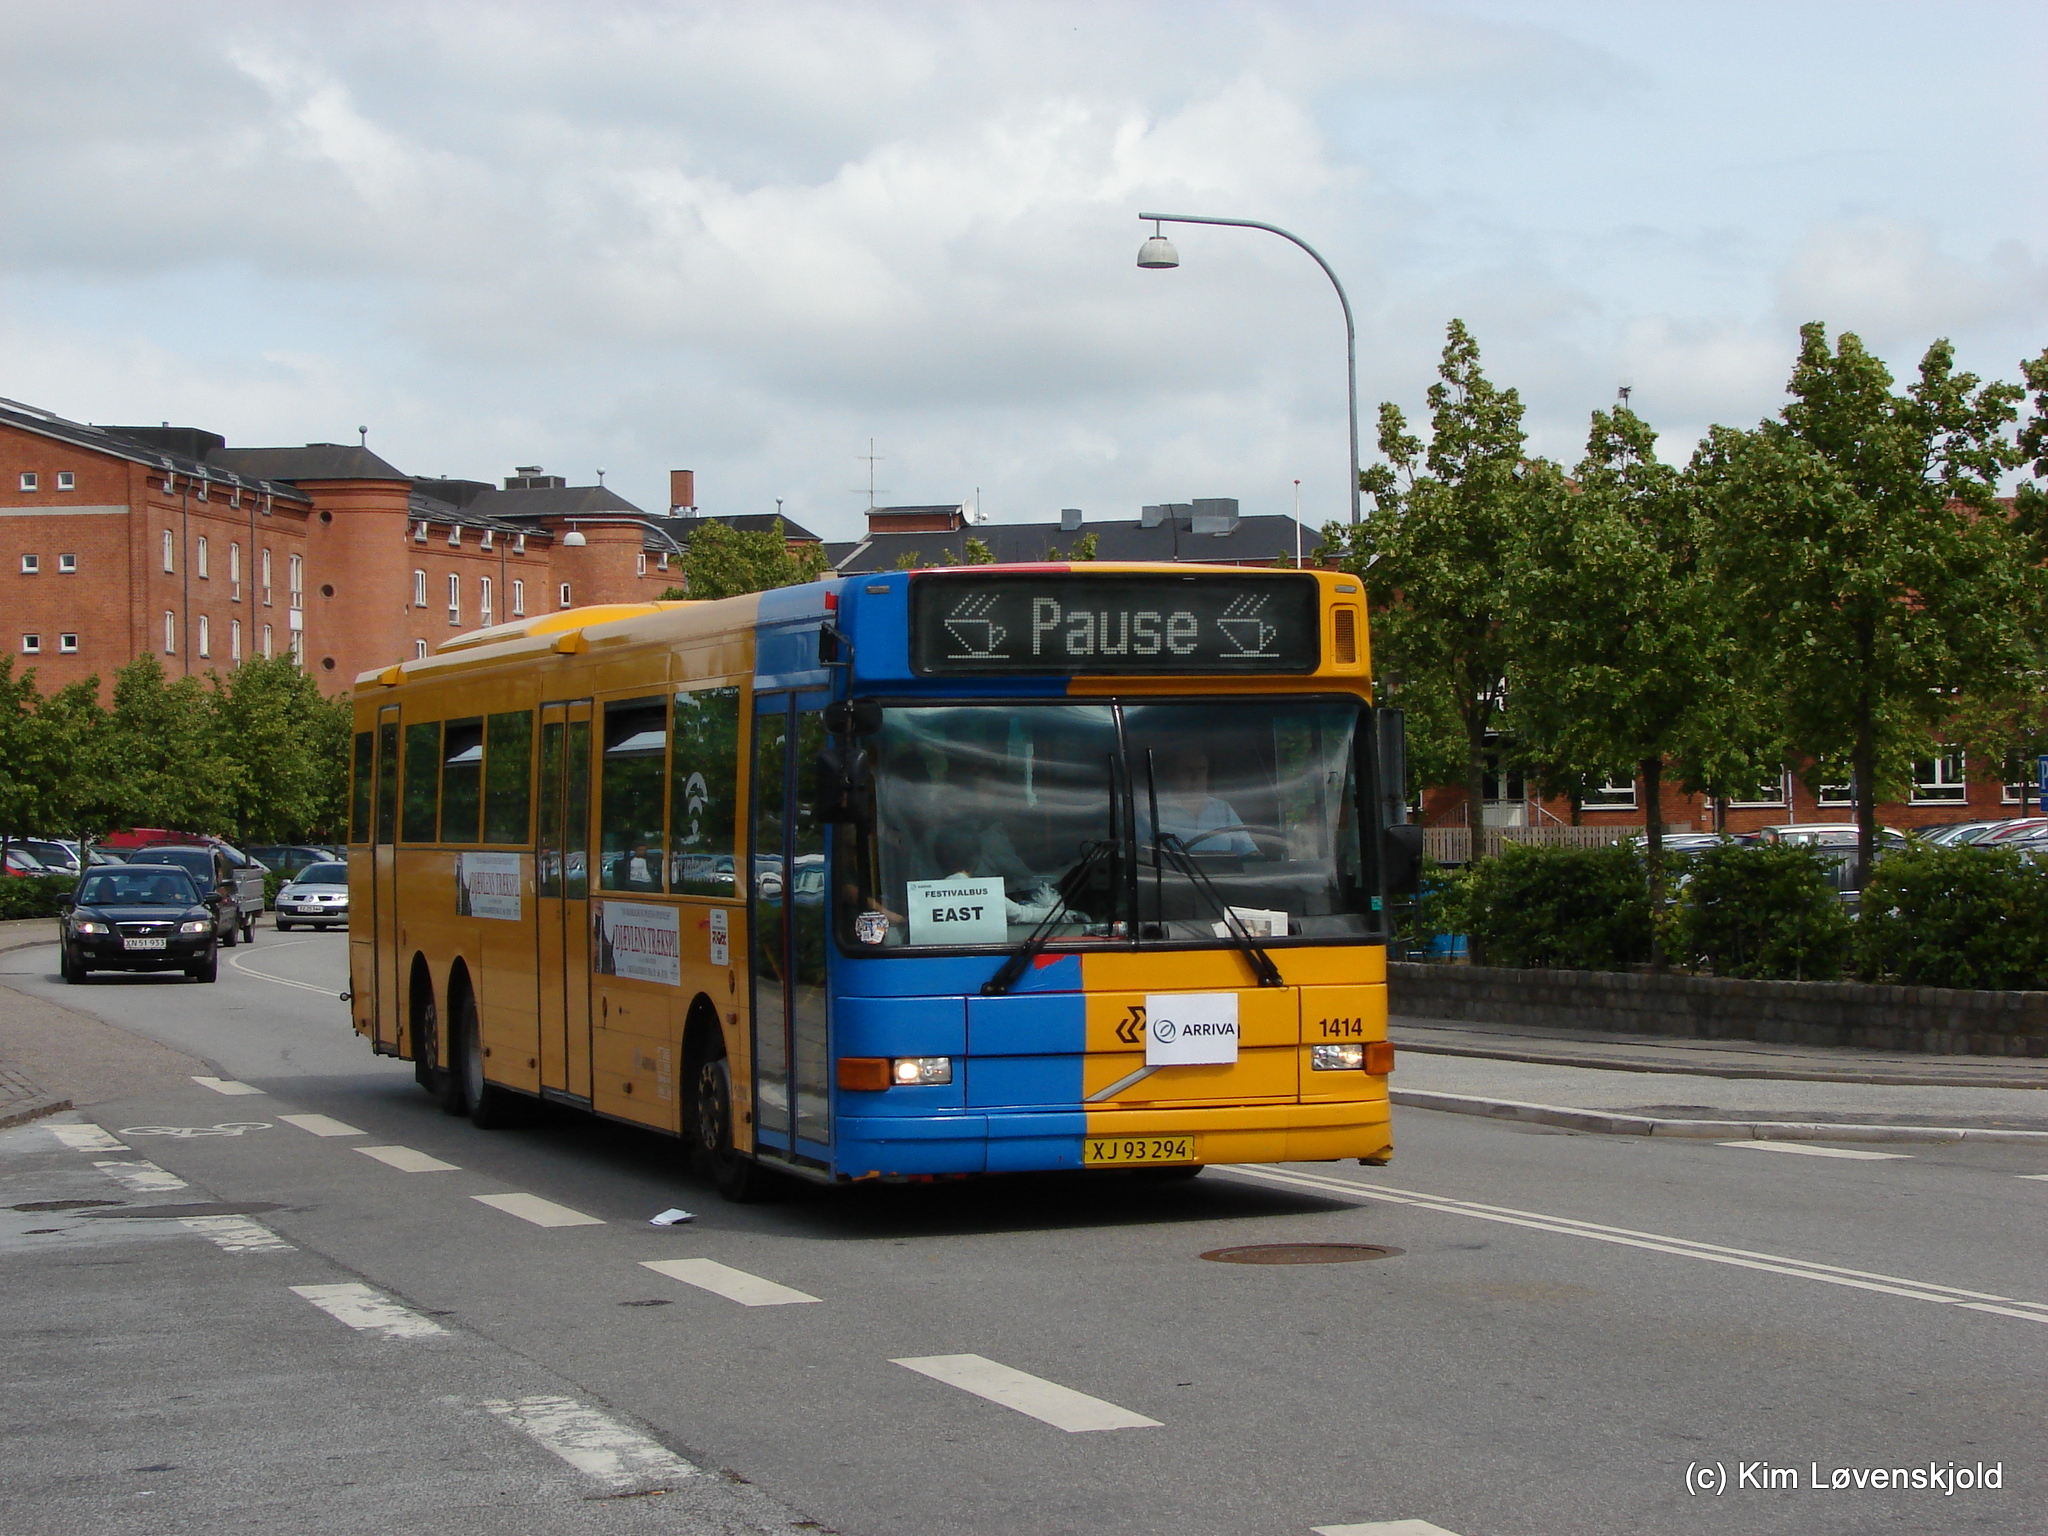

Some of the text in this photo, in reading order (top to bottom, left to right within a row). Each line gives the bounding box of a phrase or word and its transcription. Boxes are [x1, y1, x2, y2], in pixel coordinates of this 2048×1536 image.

[1033, 597, 1198, 655] Pause
[925, 888, 988, 898] FESTIVALBUS
[932, 906, 984, 923] EAST
[1182, 1023, 1235, 1037] ARRIVA
[1319, 1018, 1363, 1037] 1414
[1093, 1140, 1186, 1160] XJ 93 294
